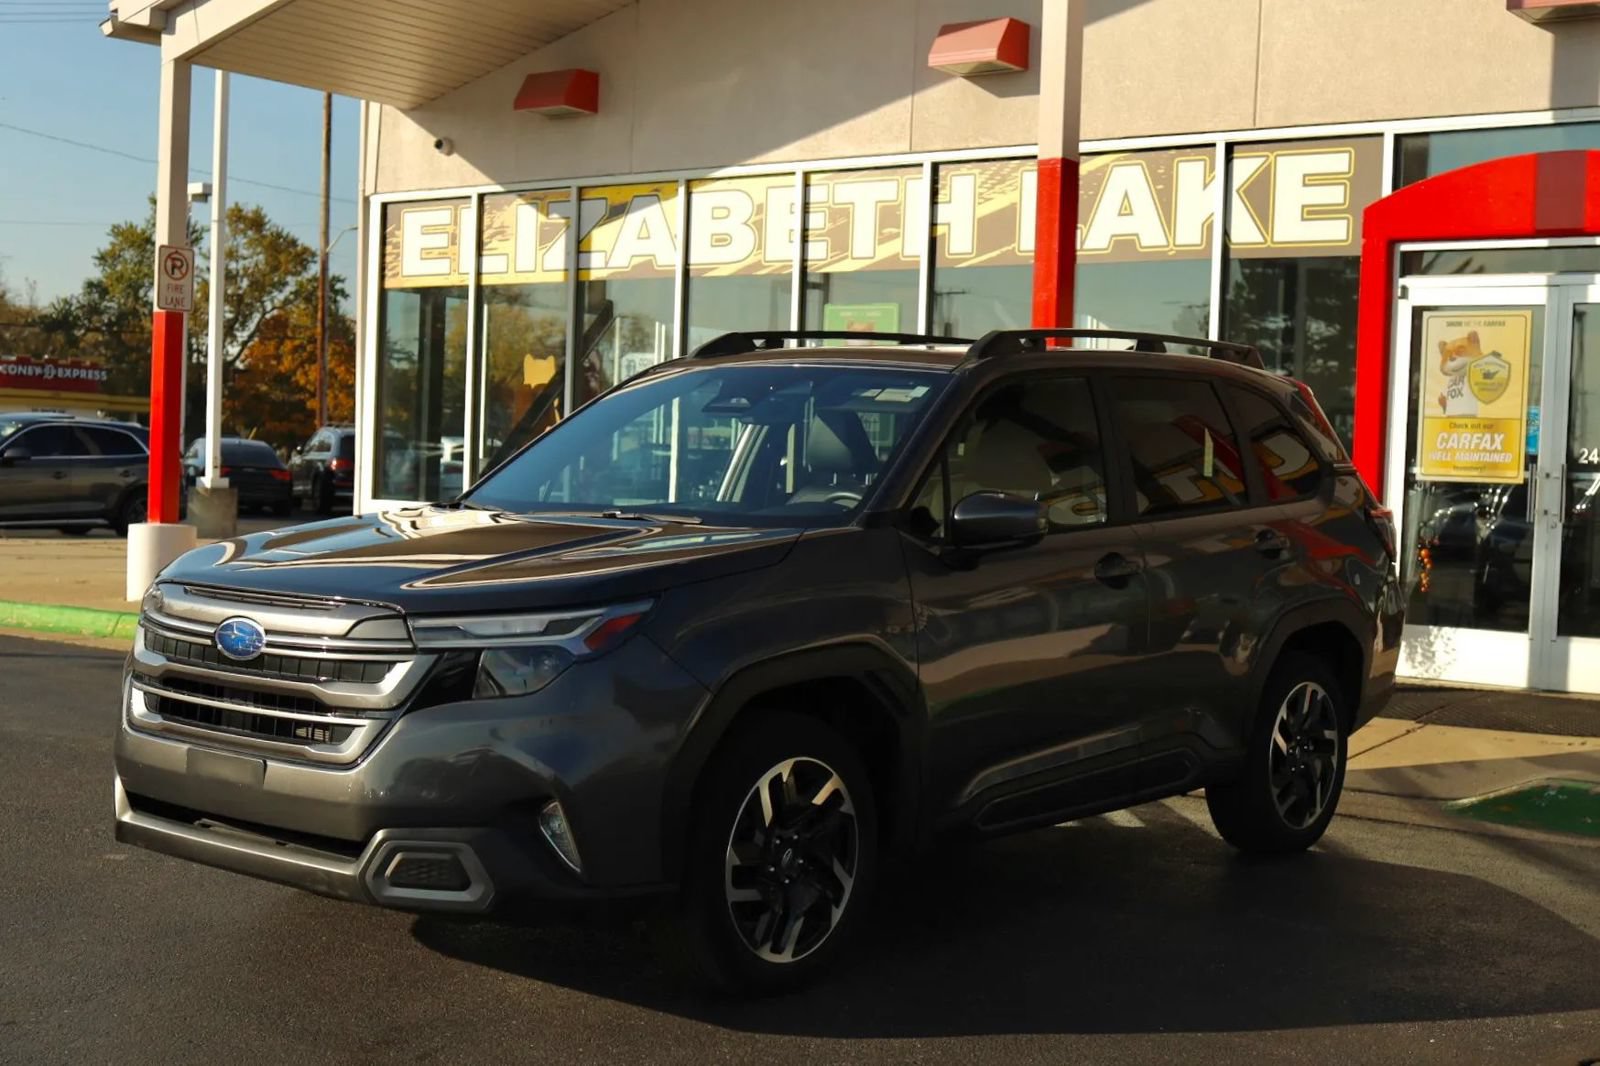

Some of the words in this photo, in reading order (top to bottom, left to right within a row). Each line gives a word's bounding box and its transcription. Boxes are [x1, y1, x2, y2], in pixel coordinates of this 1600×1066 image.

[400, 172, 978, 278] ELIZABETH
[167, 283, 184, 294] FIRE
[165, 295, 185, 307] LANE
[57, 367, 107, 380] EXPRESS
[1436, 432, 1504, 450] CARFAX
[1455, 452, 1513, 463] MAINTAINED
[1578, 447, 1599, 464] 24
